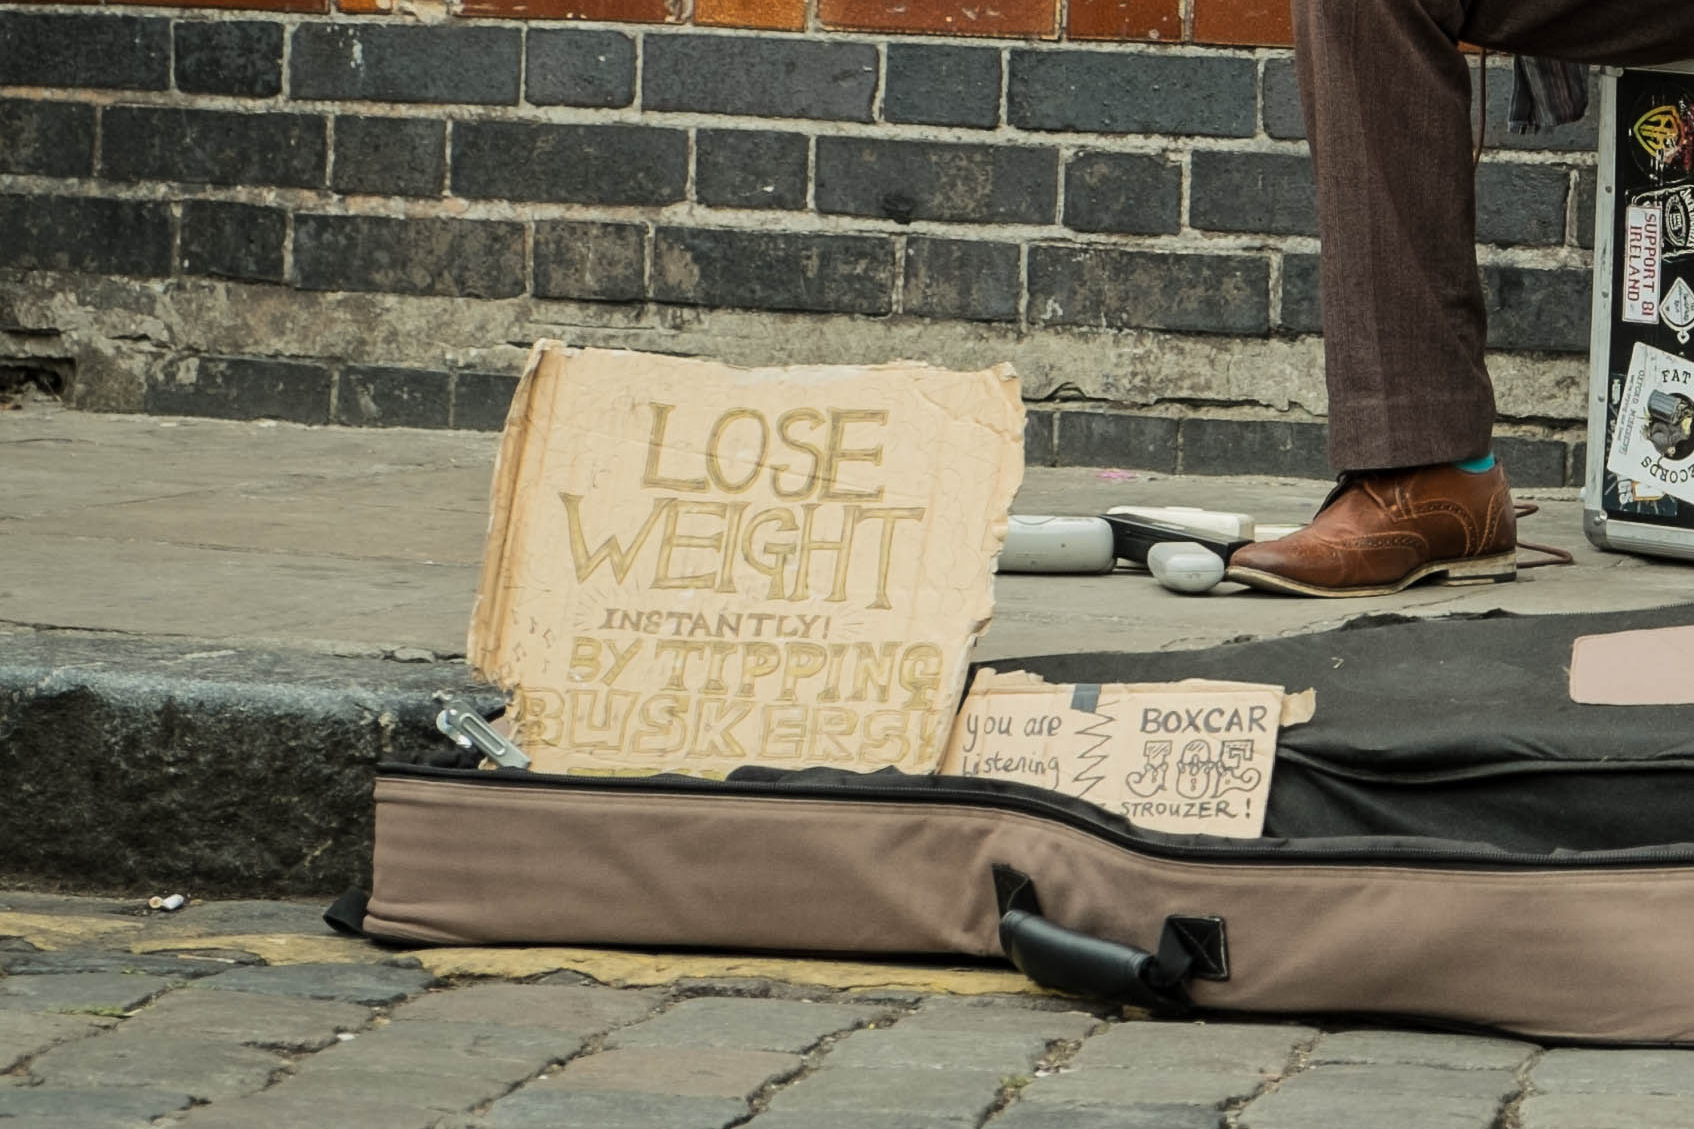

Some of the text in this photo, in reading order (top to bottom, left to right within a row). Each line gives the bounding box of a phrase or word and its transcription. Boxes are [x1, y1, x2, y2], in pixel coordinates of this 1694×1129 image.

[1627, 225, 1642, 301] IRELAND
[1642, 213, 1657, 293] SUPPORT
[1661, 369, 1691, 384] FAT
[640, 401, 889, 503] LOSE
[559, 491, 926, 610] WEIGHT
[600, 608, 831, 639] INSTANTLY!
[569, 637, 944, 711] BY TIPPING
[521, 687, 940, 765] BUSKERS!
[963, 713, 1062, 752] you are
[1139, 705, 1268, 733] BOXCAR
